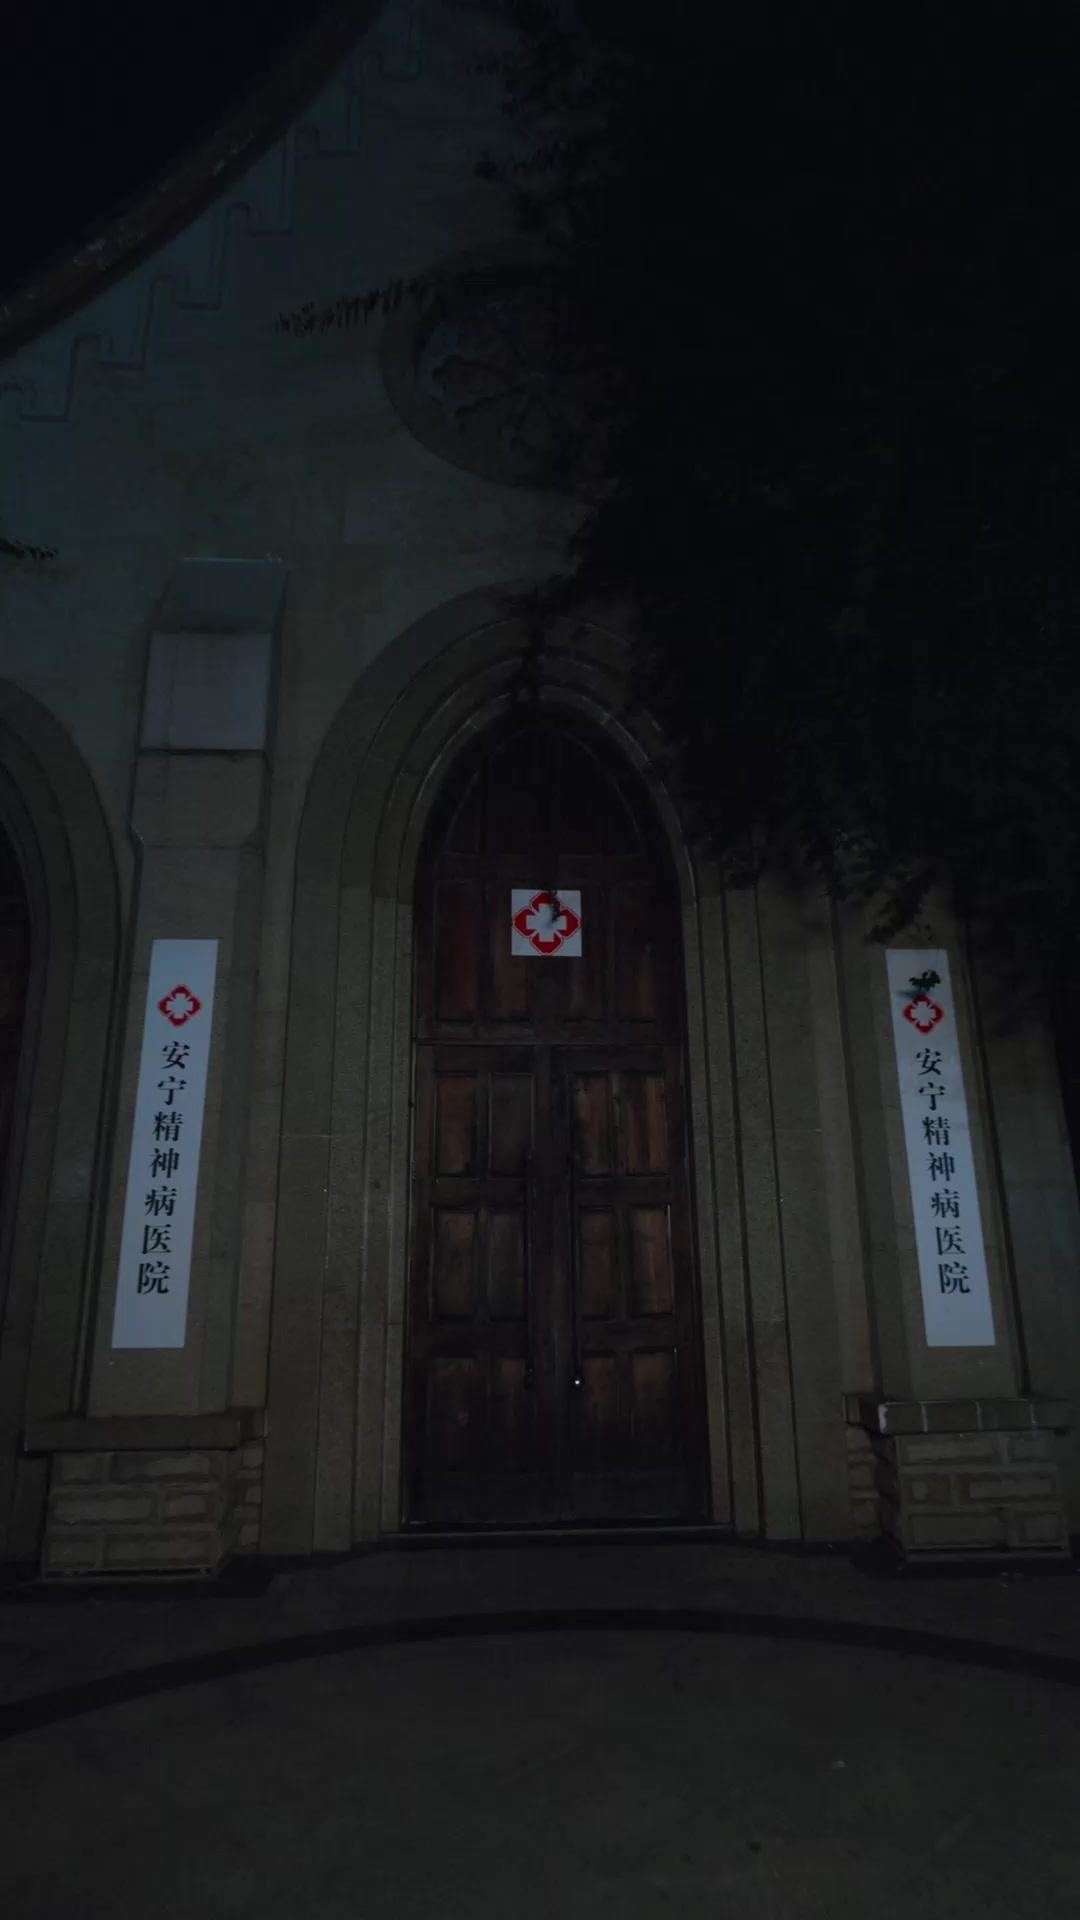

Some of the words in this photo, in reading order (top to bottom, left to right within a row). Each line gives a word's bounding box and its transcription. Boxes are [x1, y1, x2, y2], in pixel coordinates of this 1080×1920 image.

[137, 1041, 190, 1294] 安宁精神病医院
[916, 1048, 970, 1294] 安宁精神病医院
